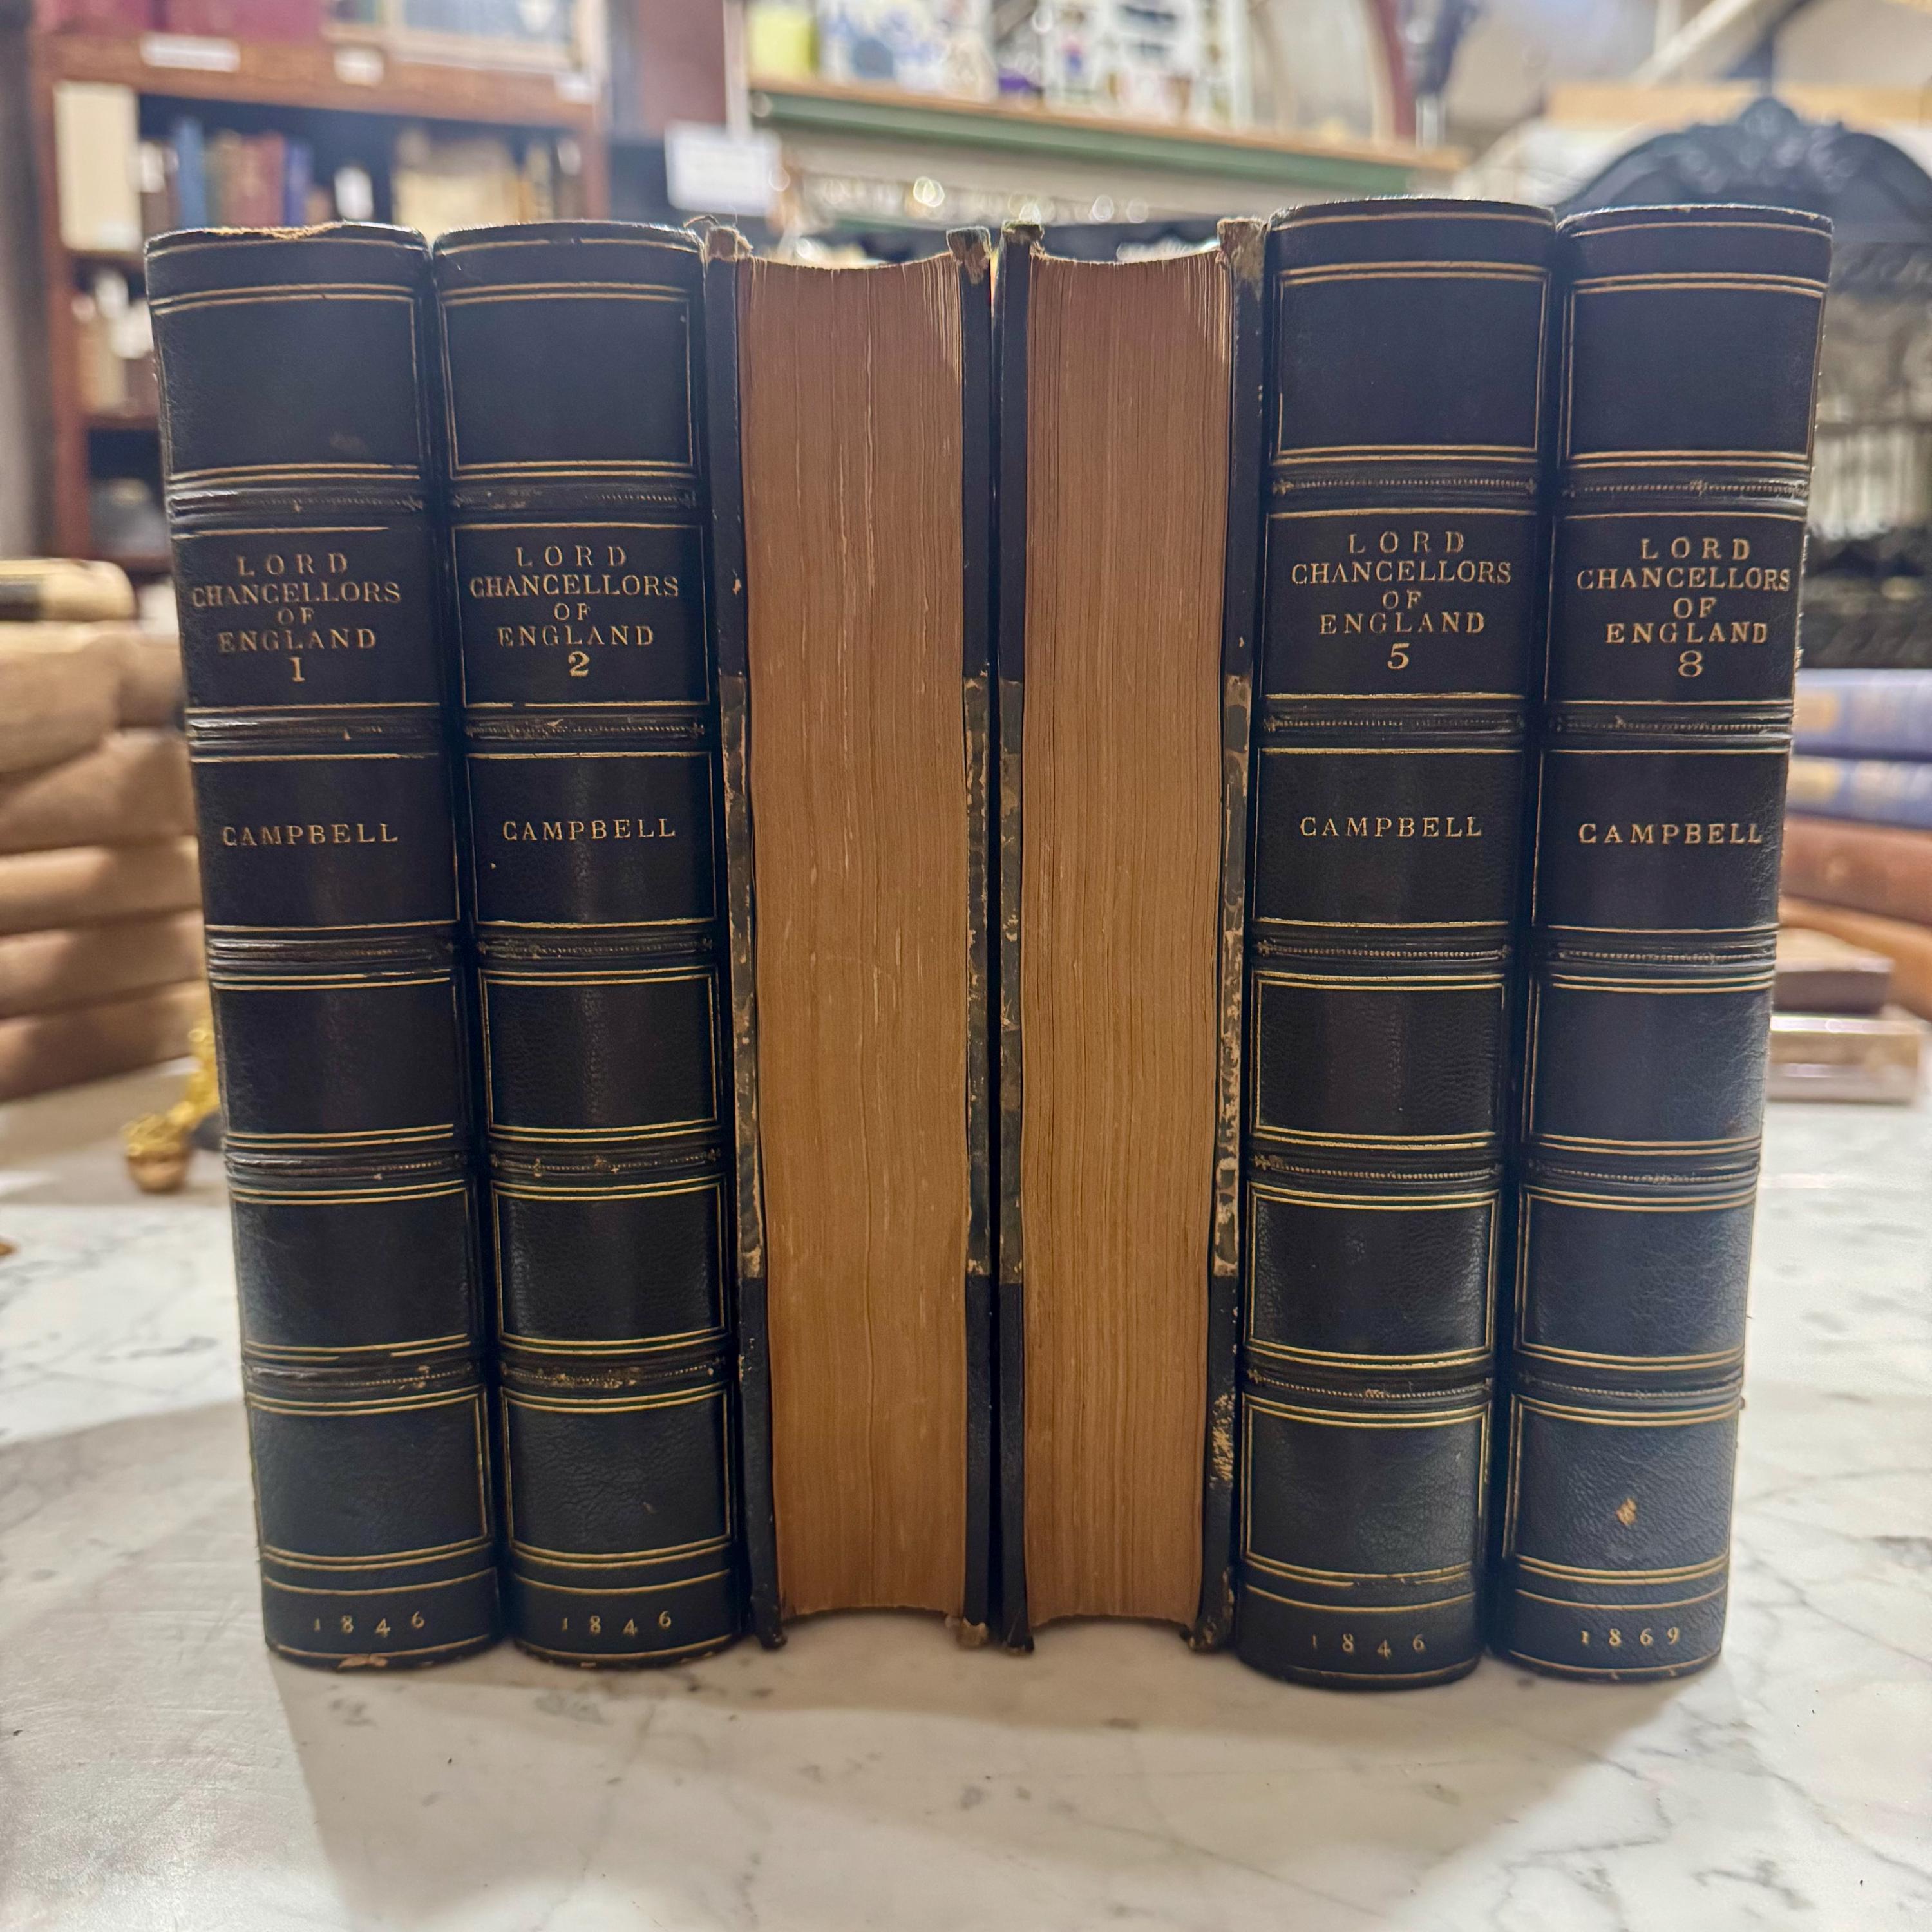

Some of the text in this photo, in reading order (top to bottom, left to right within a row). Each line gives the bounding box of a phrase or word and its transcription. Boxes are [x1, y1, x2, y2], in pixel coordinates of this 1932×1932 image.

[1349, 531, 1464, 554] LORD
[1641, 537, 1750, 560] LORD
[236, 553, 348, 577] LORD
[516, 545, 626, 567] LORD
[1291, 560, 1511, 585] CHANCELLORS
[1577, 567, 1791, 592] CHANCELLORS
[193, 582, 402, 608] CHANCELLORS
[469, 574, 679, 598] CHANCELLORS
[1382, 589, 1422, 609] OF
[1673, 597, 1717, 619] OF
[278, 607, 314, 625] OF
[554, 602, 591, 621] OF
[1320, 612, 1485, 635] ENGLAND
[1605, 622, 1768, 644] ENGLAND
[217, 628, 377, 653] ENGLAND
[497, 625, 655, 647] ENGLAND
[567, 650, 591, 677] 2
[1387, 643, 1410, 670] 5
[1678, 650, 1705, 677] 8
[222, 823, 399, 847] CAMPBELL
[502, 818, 677, 841] CAMPBELL
[1300, 816, 1482, 837] CAMPBELL
[1578, 822, 1764, 845] CAMPBELL
[313, 1611, 425, 1638] 1846
[562, 1611, 672, 1637] 1846
[1311, 1633, 1426, 1659] 1846
[1580, 1627, 1680, 1647] 1869
